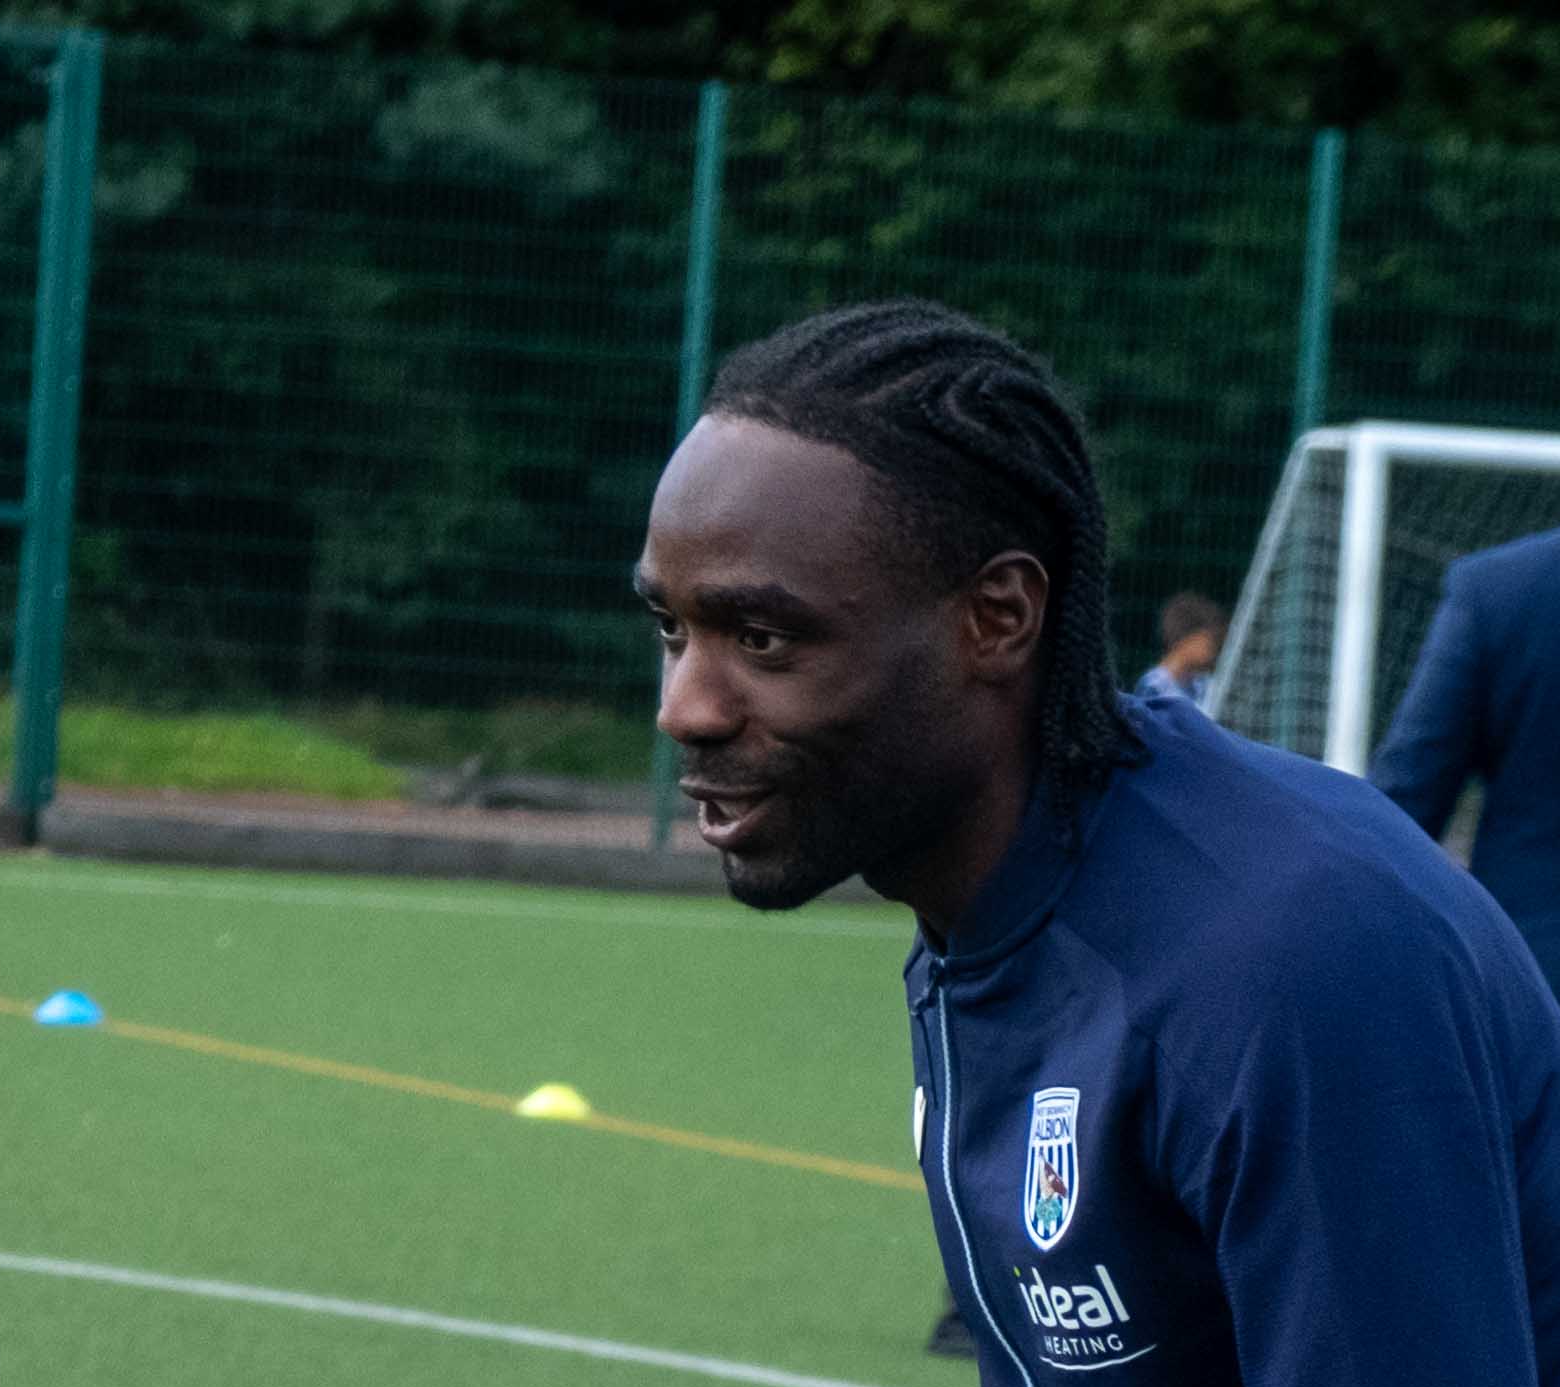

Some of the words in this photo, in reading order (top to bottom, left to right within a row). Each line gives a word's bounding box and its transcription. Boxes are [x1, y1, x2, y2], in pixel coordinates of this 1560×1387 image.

[1034, 1117, 1071, 1140] ALBION
[1013, 1264, 1130, 1329] ideal
[1044, 1334, 1123, 1355] HEATING
